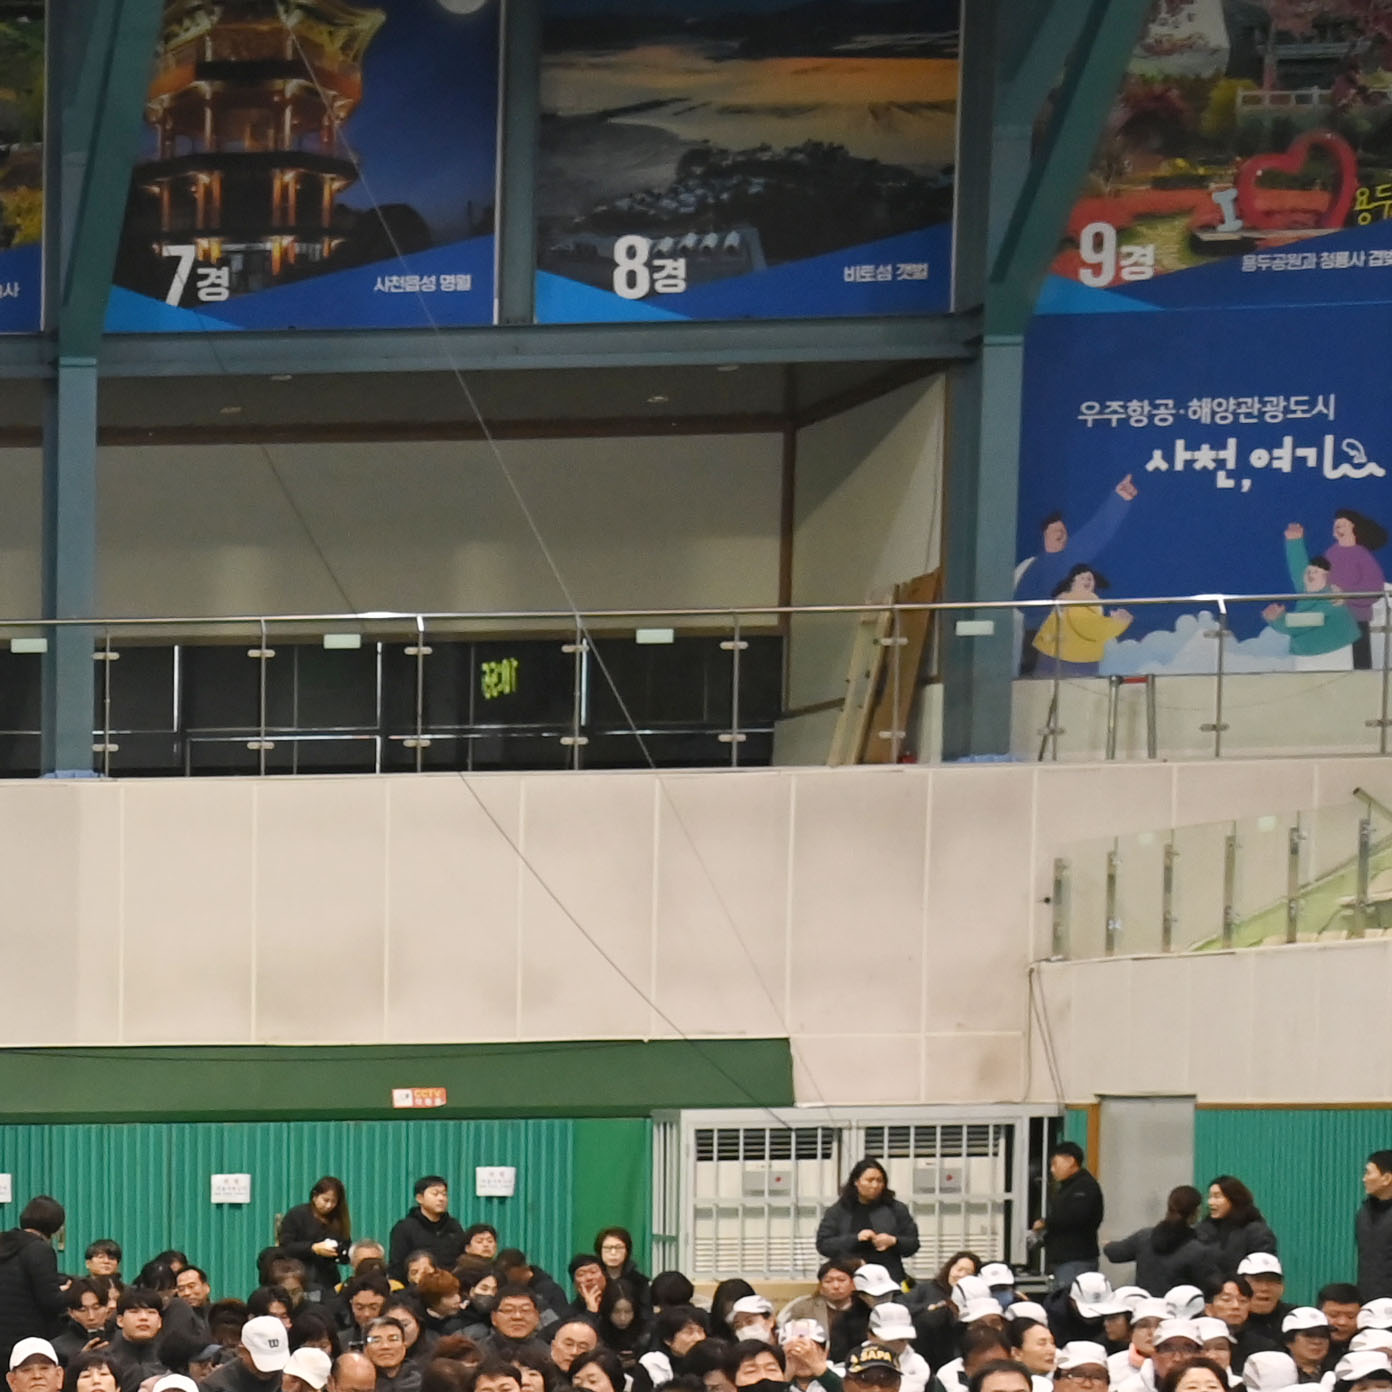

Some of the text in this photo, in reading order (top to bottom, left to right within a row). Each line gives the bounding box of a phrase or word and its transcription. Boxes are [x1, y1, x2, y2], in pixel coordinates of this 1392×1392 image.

[161, 243, 230, 307] 7경
[439, 273, 472, 292] 명월
[613, 234, 687, 300] 8경
[843, 263, 893, 283] 비토섬
[1077, 221, 1155, 288] 9경
